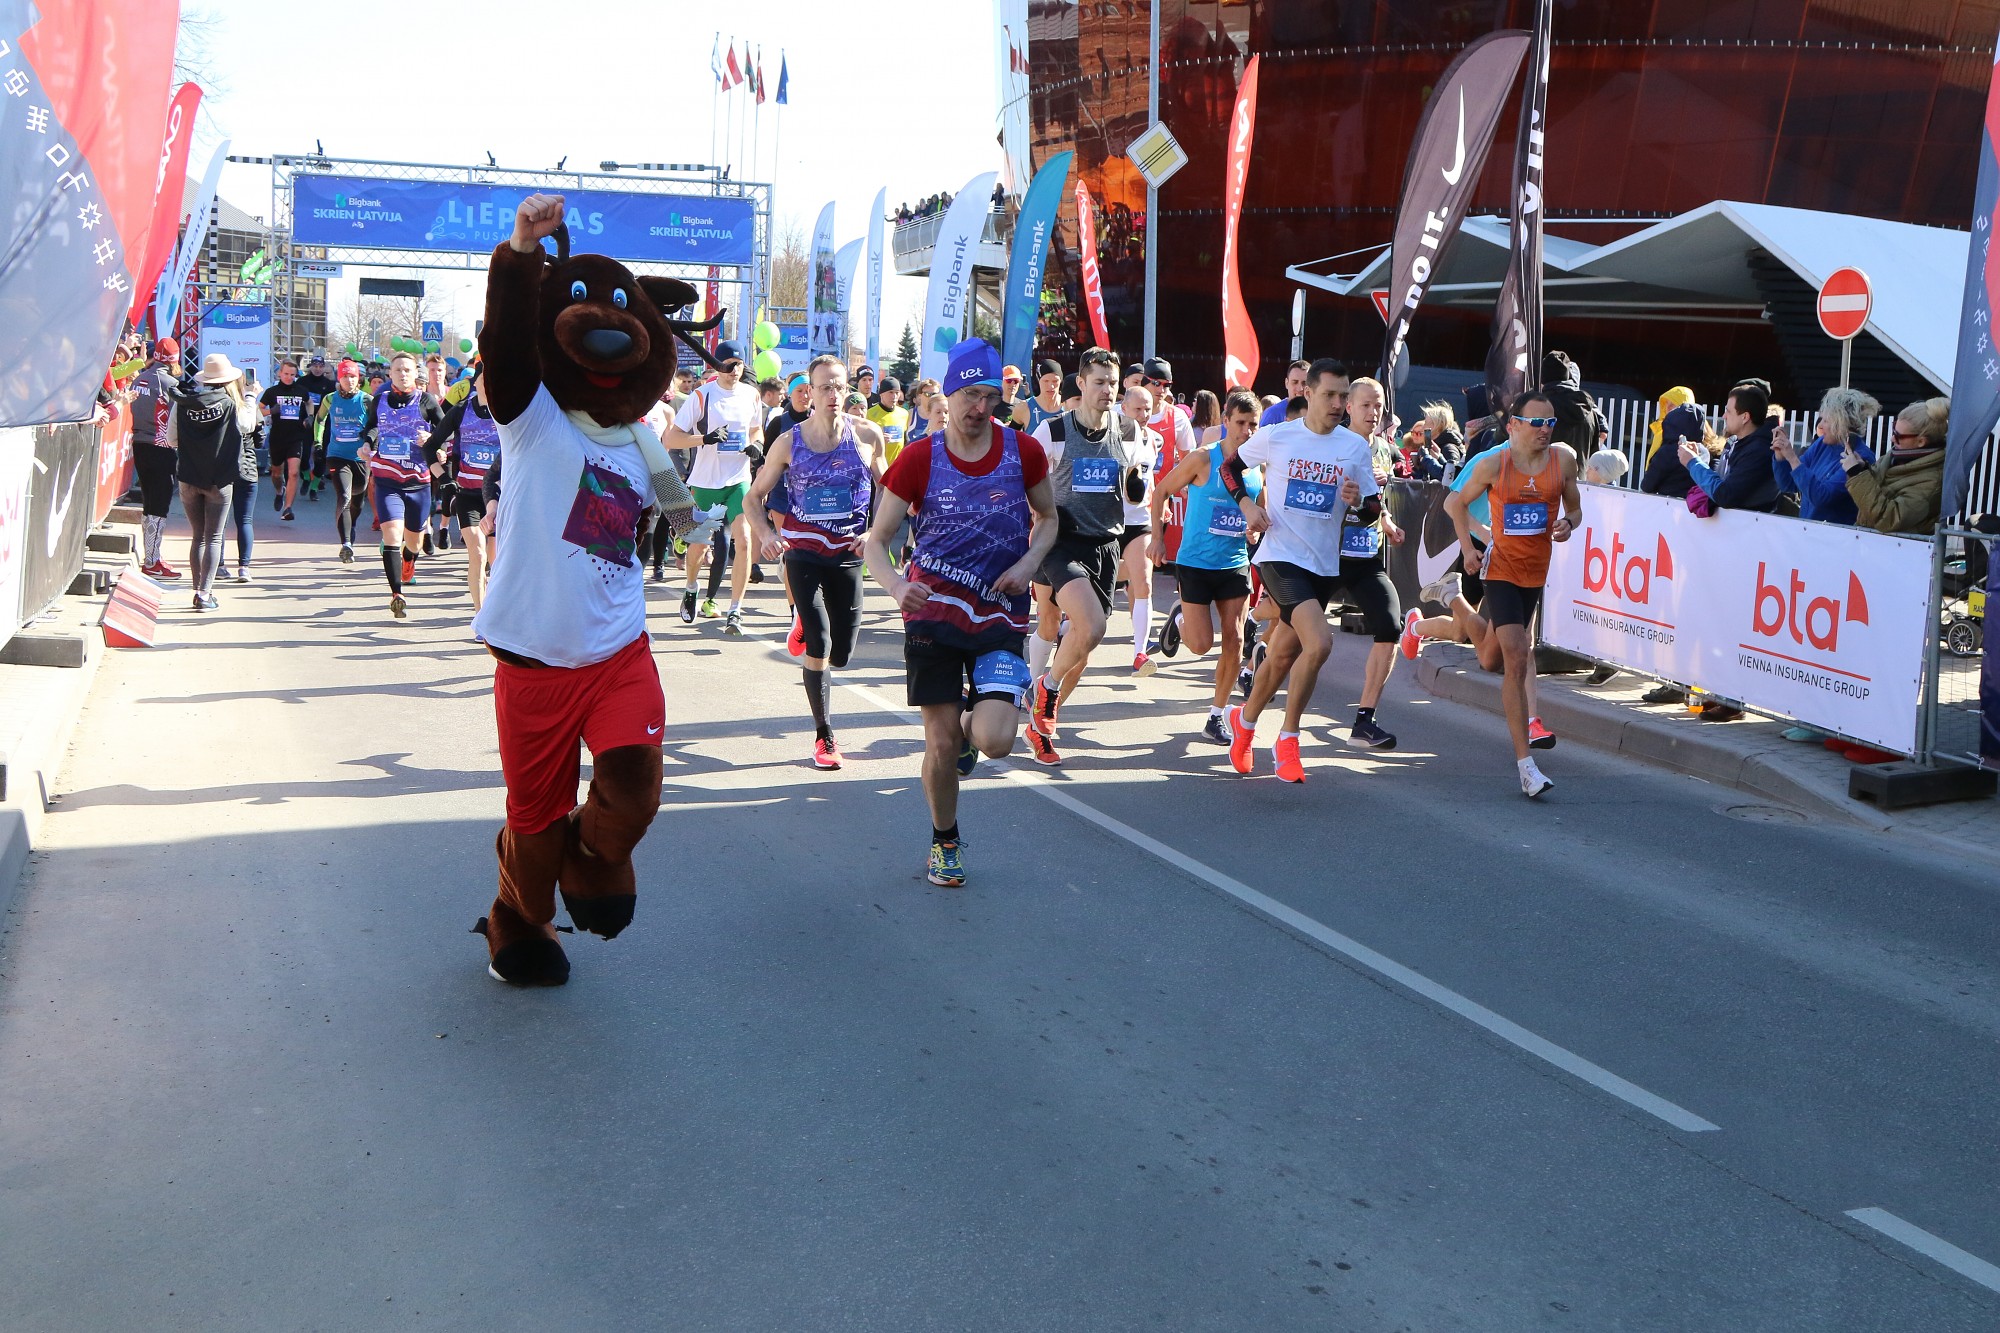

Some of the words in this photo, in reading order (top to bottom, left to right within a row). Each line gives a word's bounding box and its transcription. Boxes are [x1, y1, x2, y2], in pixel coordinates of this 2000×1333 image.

[348, 197, 382, 208] Bigbank
[313, 208, 355, 220] SKRIEN
[357, 210, 403, 222] LATVIJA
[448, 200, 604, 235] LIEPAS
[682, 216, 714, 226] Bigbank
[649, 226, 689, 238] SKRIEN
[690, 228, 734, 240] LATVIJA
[1024, 219, 1045, 298] Bigbank
[1404, 255, 1432, 310] DO
[1420, 206, 1449, 250] IT.
[942, 234, 969, 319] Bigbank
[226, 313, 260, 324] Bigbank
[959, 367, 984, 380] tet
[476, 451, 495, 461] 391
[1082, 468, 1110, 480] 344
[1288, 458, 1344, 476] #SKRIEN
[1288, 467, 1338, 485] LATVIJA
[1296, 490, 1325, 506] 309
[1220, 515, 1242, 527] 308
[1513, 512, 1539, 525] 359
[1351, 535, 1372, 547] 338
[920, 552, 982, 589] MARATONA
[1583, 526, 1652, 605] bta
[1752, 561, 1841, 653] bta
[1572, 608, 1599, 625] VIENNA
[1600, 617, 1645, 638] INSURANCE
[1647, 628, 1675, 645] GROUP
[1738, 653, 1772, 674] VIENNA
[1774, 663, 1832, 691] INSURANCE
[1833, 680, 1870, 701] GROUP
